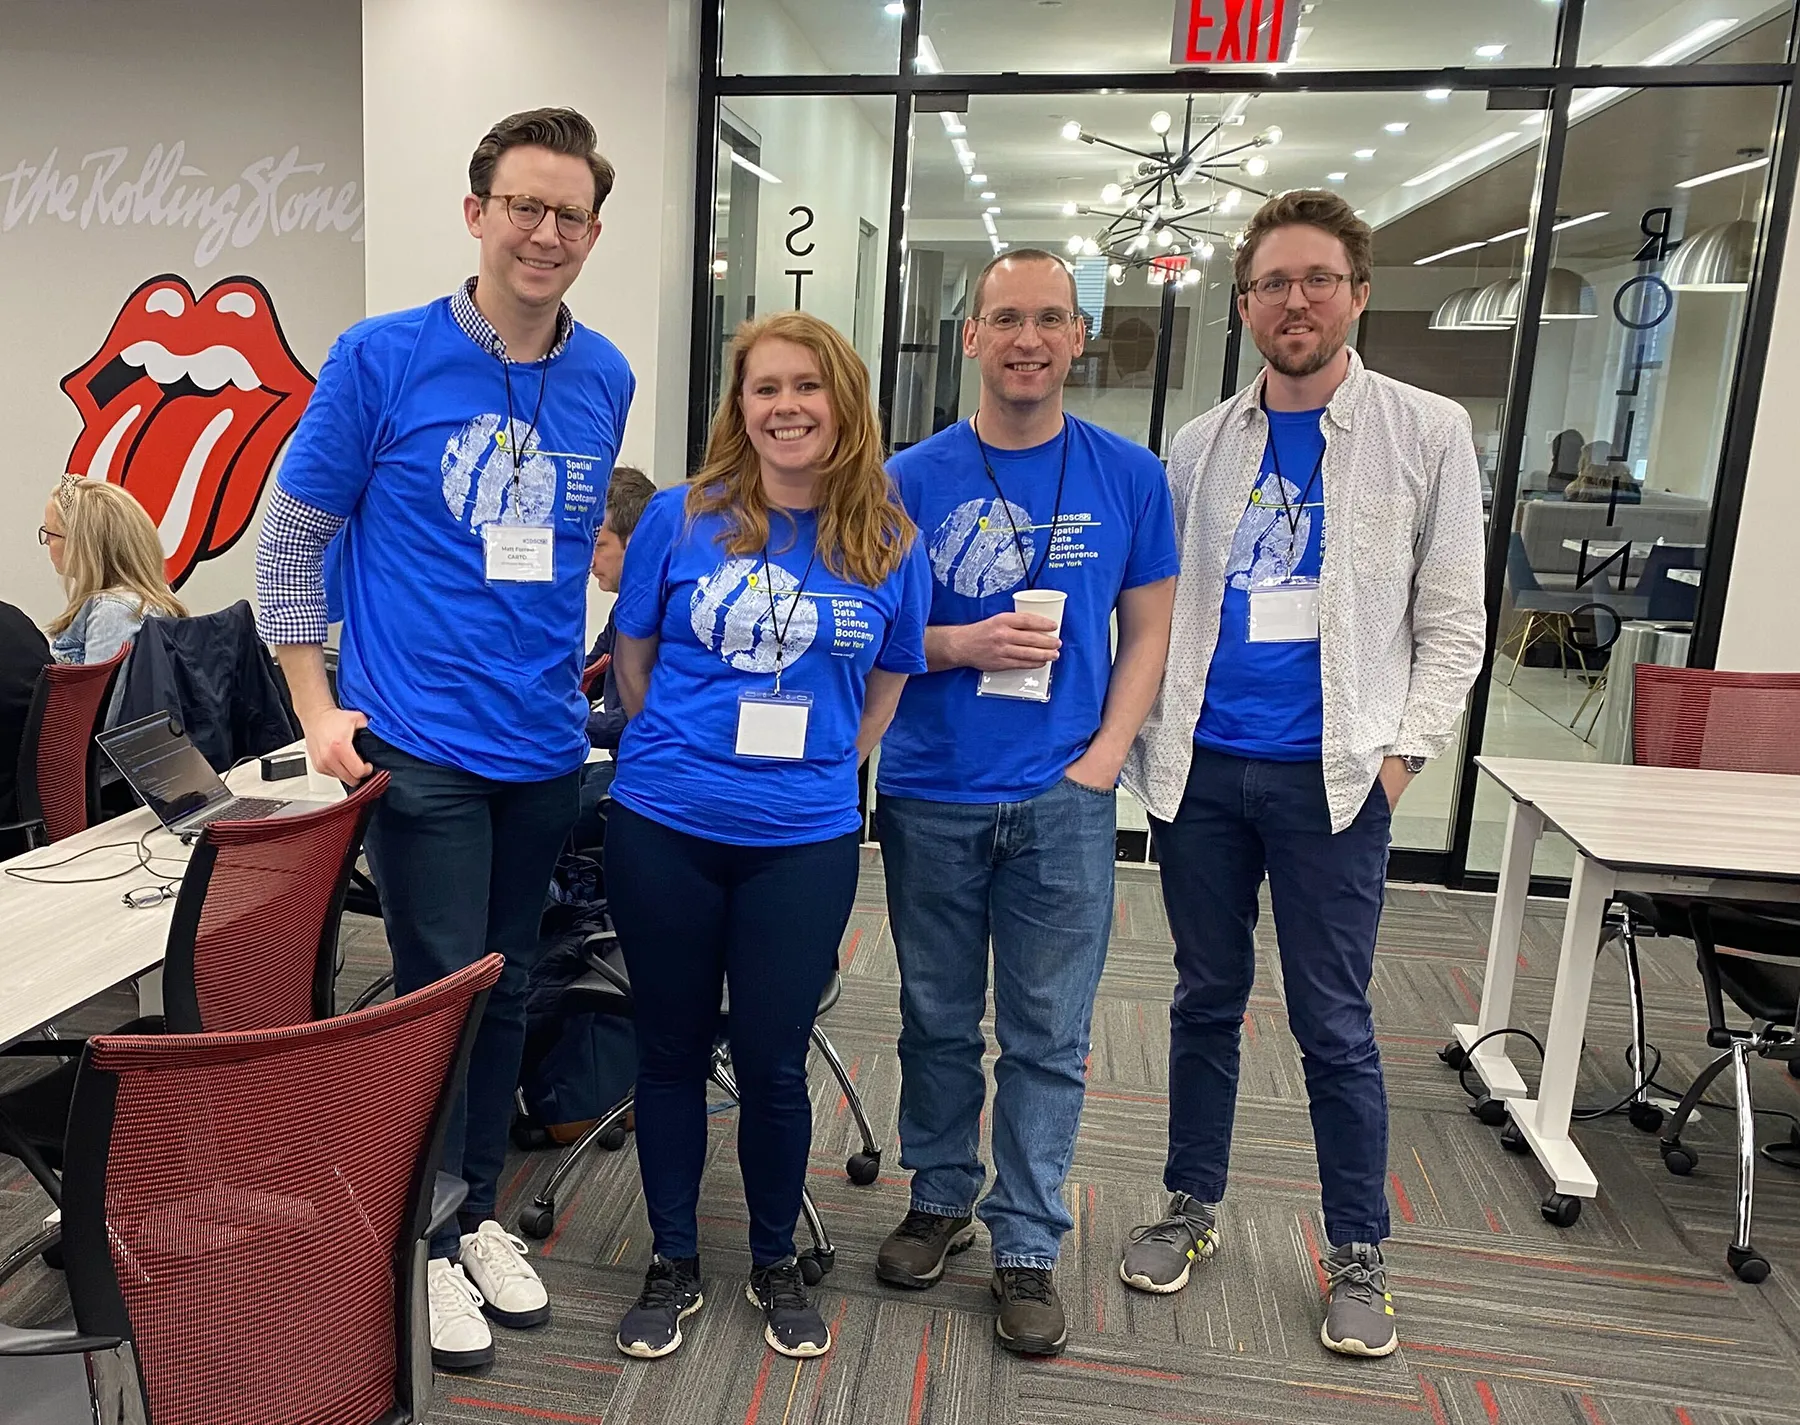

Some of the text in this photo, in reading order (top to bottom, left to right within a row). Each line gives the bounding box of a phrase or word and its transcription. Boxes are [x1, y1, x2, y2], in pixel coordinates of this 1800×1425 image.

[80, 139, 243, 268] Rolling
[566, 459, 592, 471] Spatial
[567, 471, 585, 480] Data
[566, 481, 594, 493] Science
[1051, 535, 1072, 544] Data
[1049, 543, 1085, 552] Science
[1048, 551, 1099, 560] Conference
[831, 599, 863, 609] Spatial
[833, 608, 856, 617] Data
[835, 617, 869, 629] Science
[835, 628, 875, 643] Bootcamp
[833, 639, 865, 649] New York
